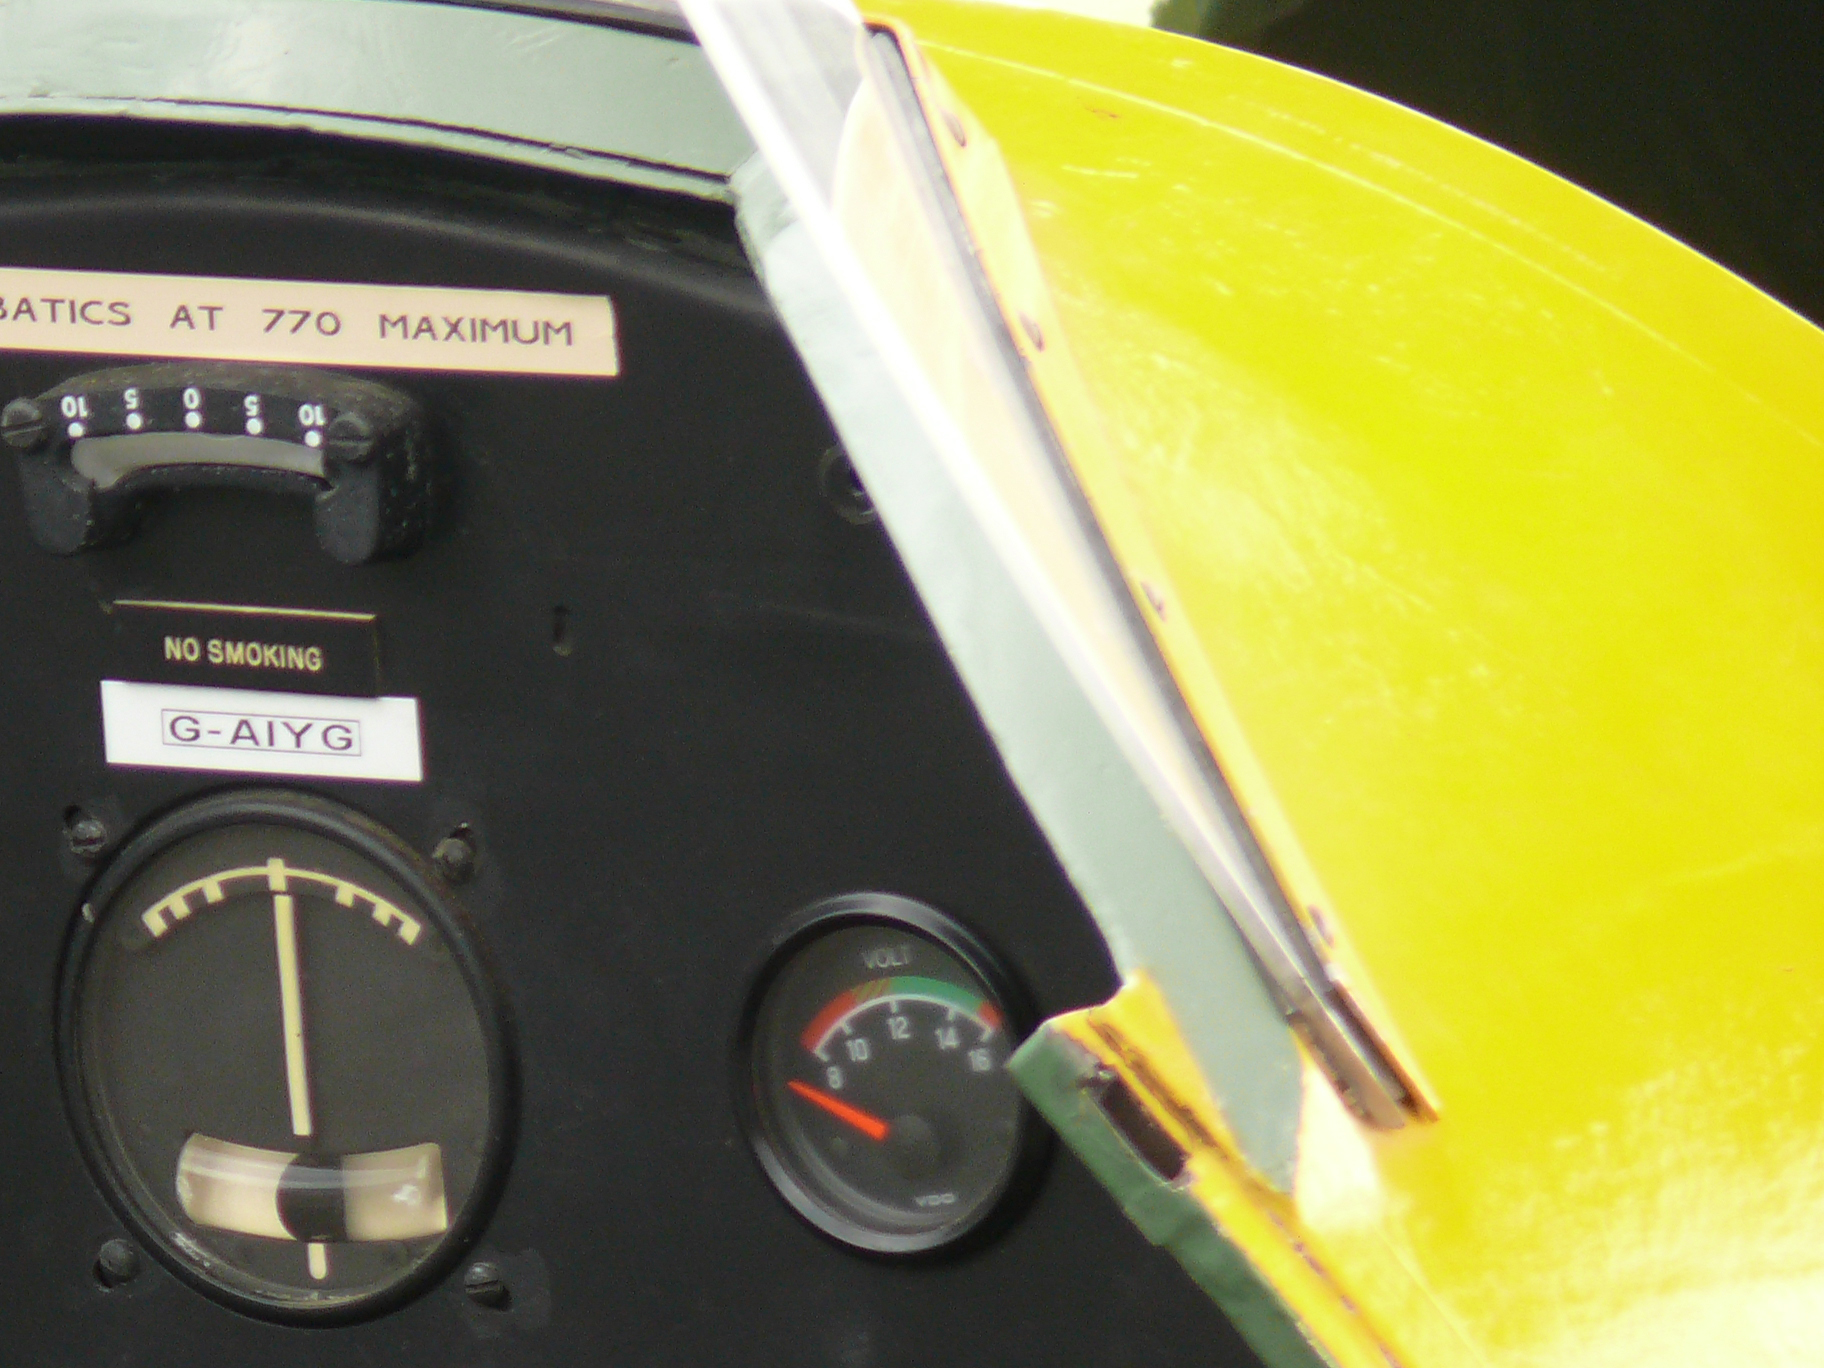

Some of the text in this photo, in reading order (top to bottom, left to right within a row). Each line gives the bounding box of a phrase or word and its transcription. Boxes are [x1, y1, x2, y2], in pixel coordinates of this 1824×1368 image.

[169, 304, 224, 332] AT
[262, 308, 342, 337] 770
[378, 313, 575, 348] MAXIMUM
[164, 635, 325, 673] NO SMOKING
[168, 714, 355, 752] G-AIYG
[887, 1016, 911, 1040] 12
[934, 1027, 960, 1051] 14
[845, 1037, 871, 1063] 10
